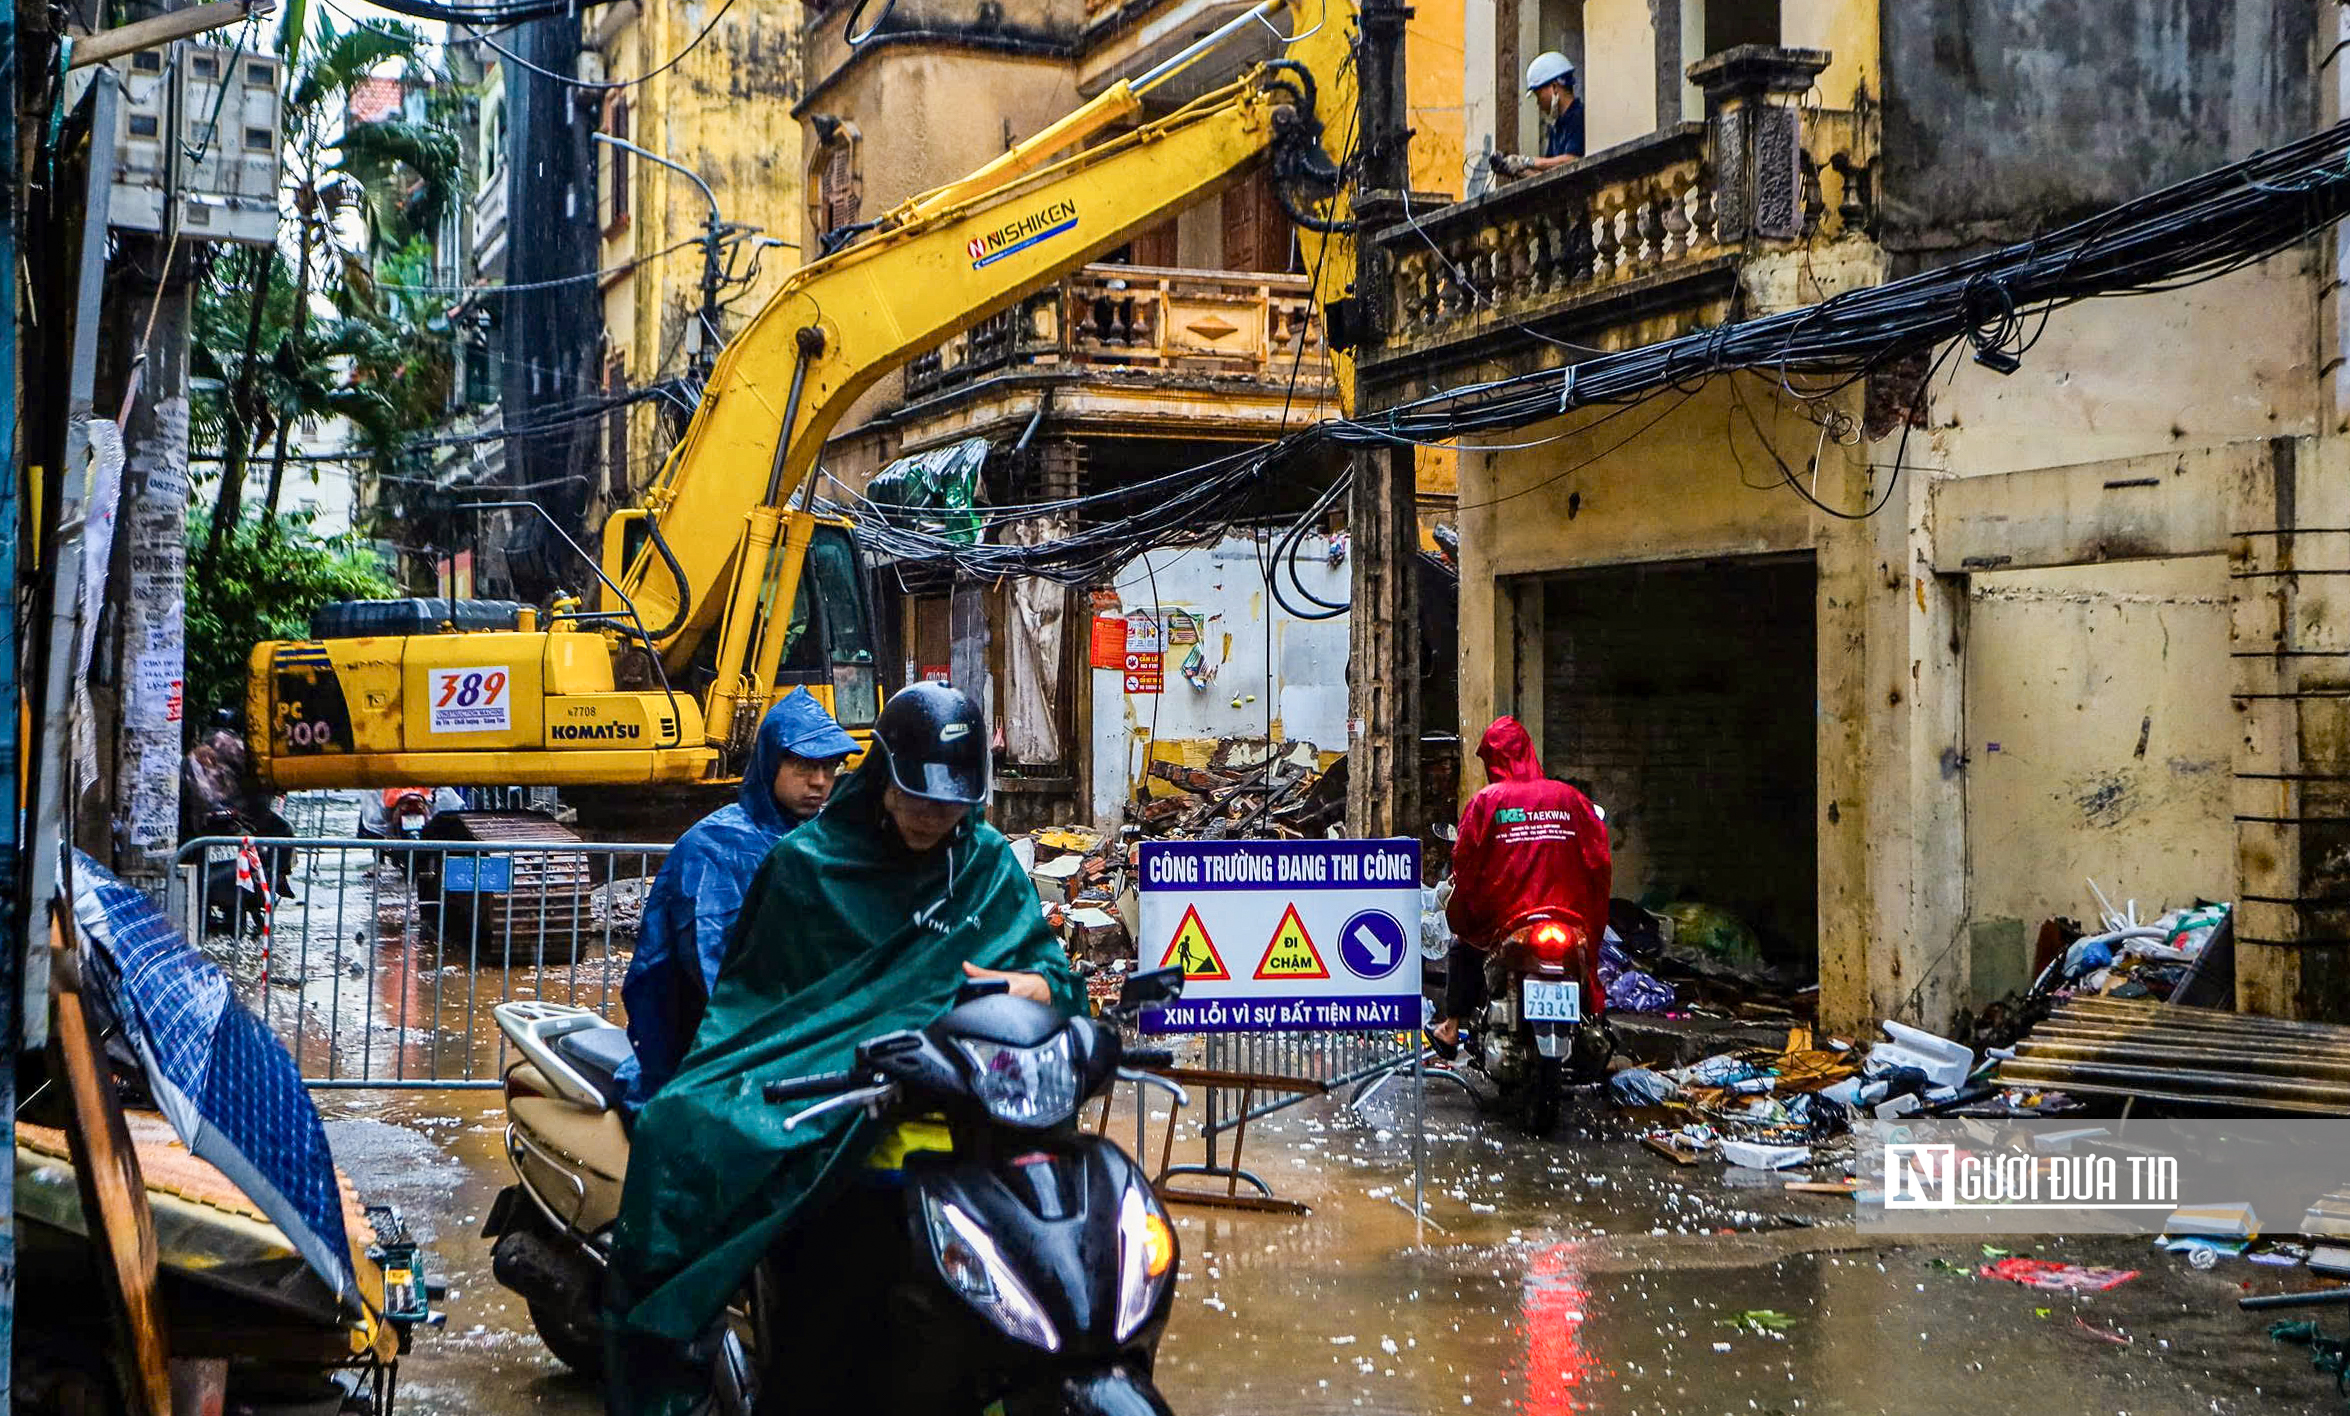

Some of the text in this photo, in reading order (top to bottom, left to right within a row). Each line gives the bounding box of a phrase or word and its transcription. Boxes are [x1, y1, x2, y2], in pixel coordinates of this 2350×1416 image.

[987, 199, 1076, 250] NISHIKEN
[436, 672, 506, 707] 389
[277, 701, 303, 719] PC
[552, 720, 640, 739] KOMATSU
[1527, 810, 1571, 822] TAEKWAN
[1149, 849, 1412, 883] CÔNG TRƯỜNG ĐANG THI CÔNG
[1284, 936, 1298, 949] ĐI
[1270, 956, 1312, 972] CHẬM
[1164, 1007, 1195, 1026] XIN
[1200, 1001, 1227, 1025] LỖI
[1232, 1003, 1249, 1024] VÌ
[1254, 1004, 1276, 1027] SỰ
[1280, 1000, 1311, 1022] BẤT
[1316, 1004, 1351, 1026] TIỆN
